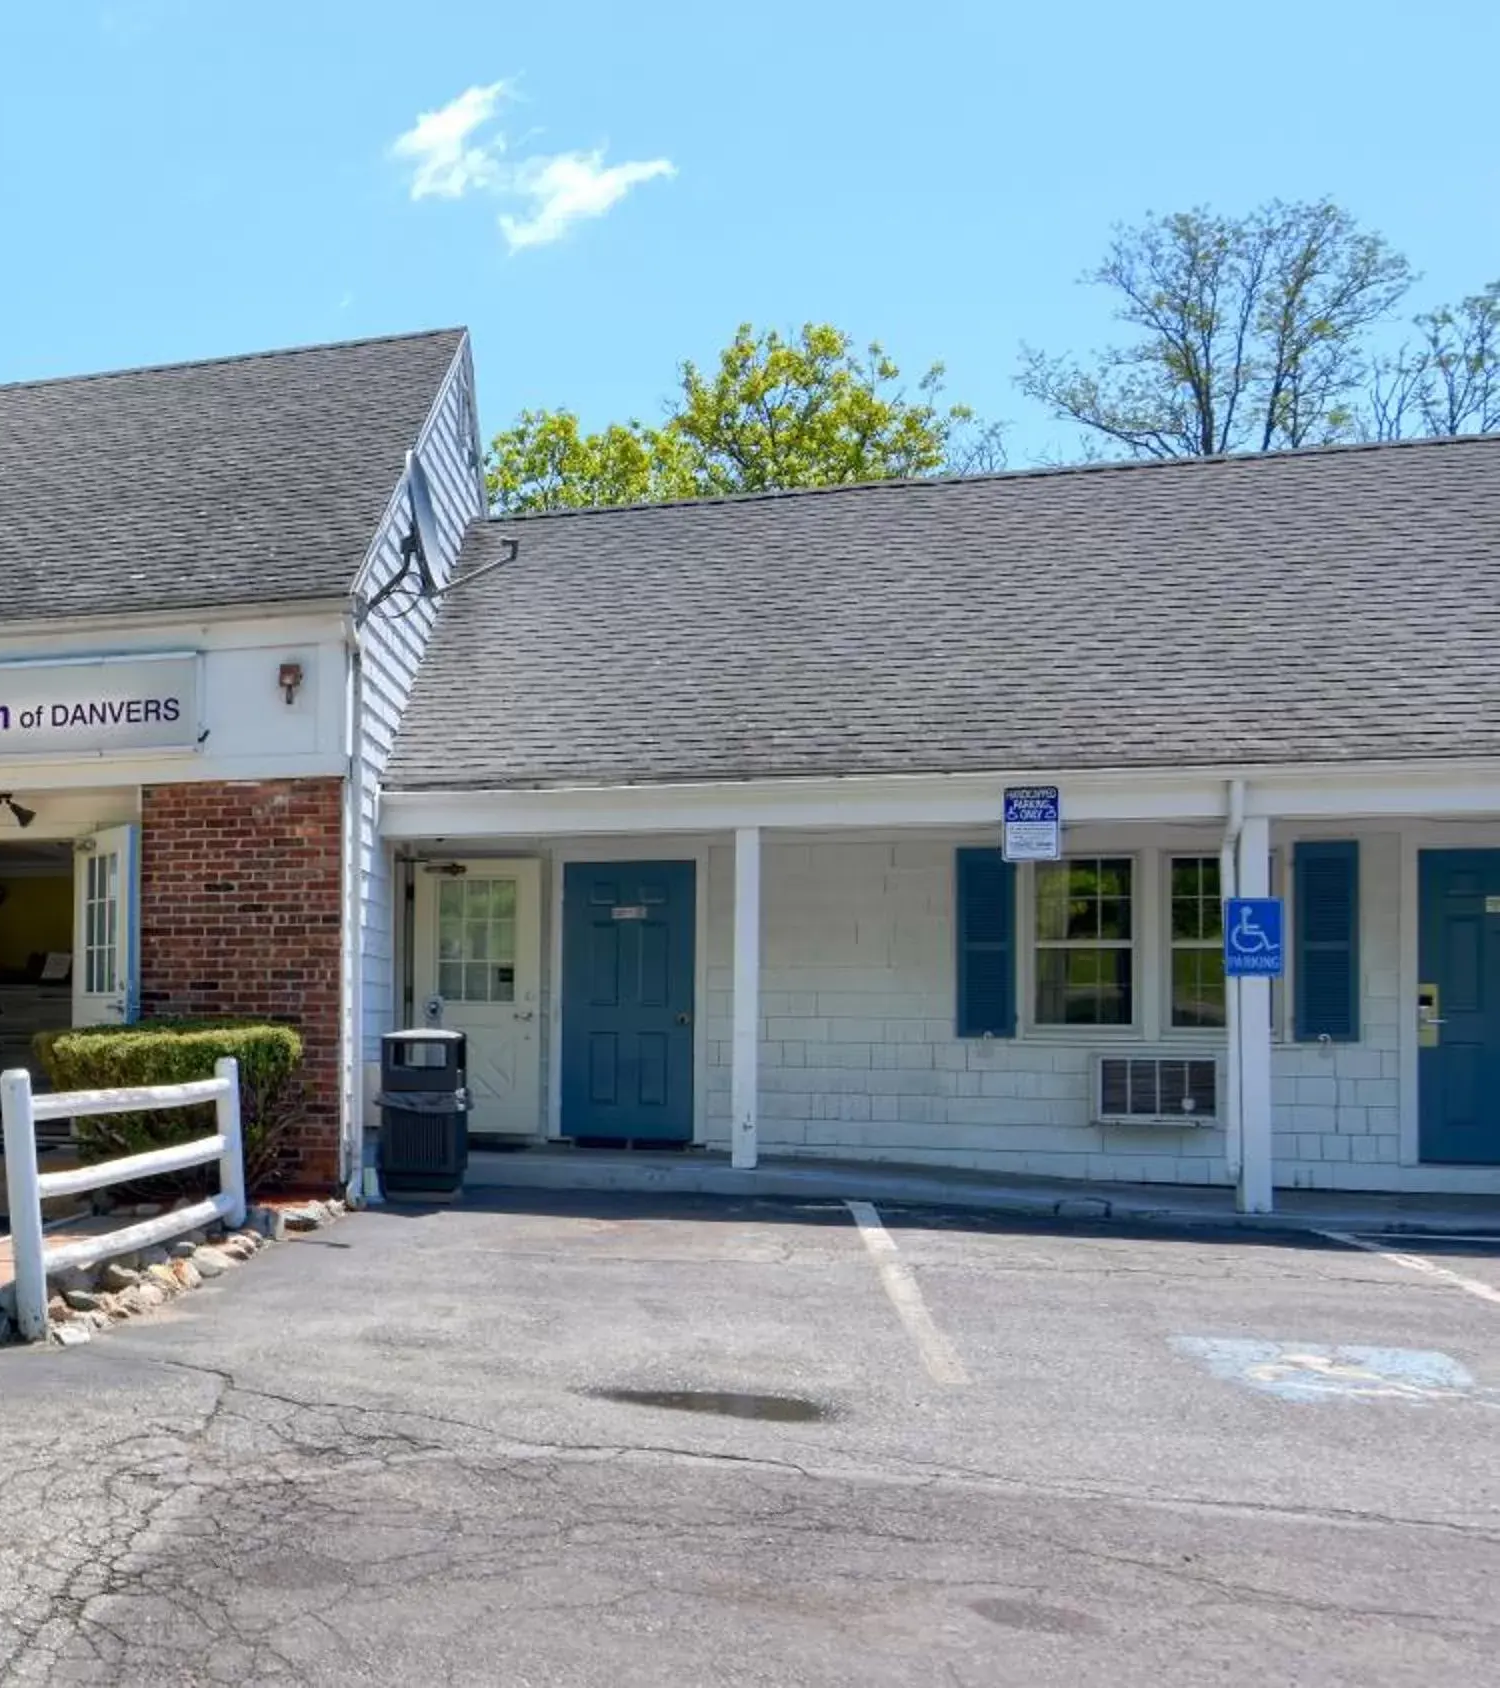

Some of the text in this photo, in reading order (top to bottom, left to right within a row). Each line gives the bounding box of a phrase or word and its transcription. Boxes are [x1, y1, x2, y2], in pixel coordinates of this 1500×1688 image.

[19, 704, 45, 729] of
[50, 697, 181, 727] DANVERS
[1013, 799, 1053, 810] PARKING
[1019, 809, 1043, 820] ONLY
[1228, 954, 1280, 970] PARKING
